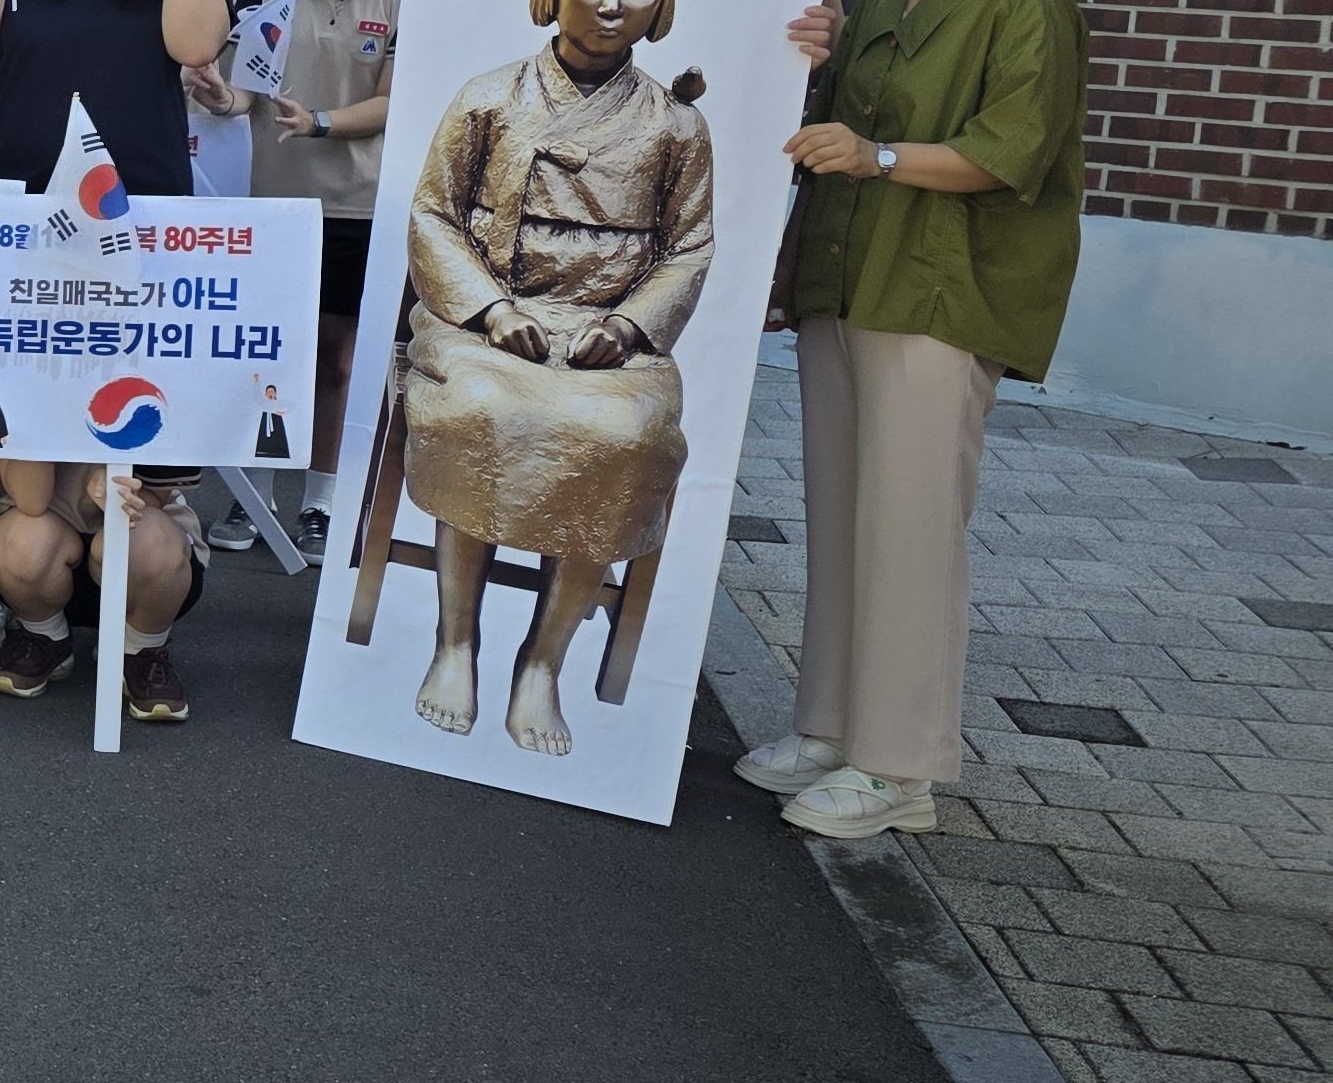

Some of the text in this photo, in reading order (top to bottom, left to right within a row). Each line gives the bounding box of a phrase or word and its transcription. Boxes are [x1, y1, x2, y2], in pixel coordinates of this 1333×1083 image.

[163, 226, 253, 255] 80주년
[9, 276, 239, 311] 친일매국노가 아닌
[210, 324, 283, 361] 나라
